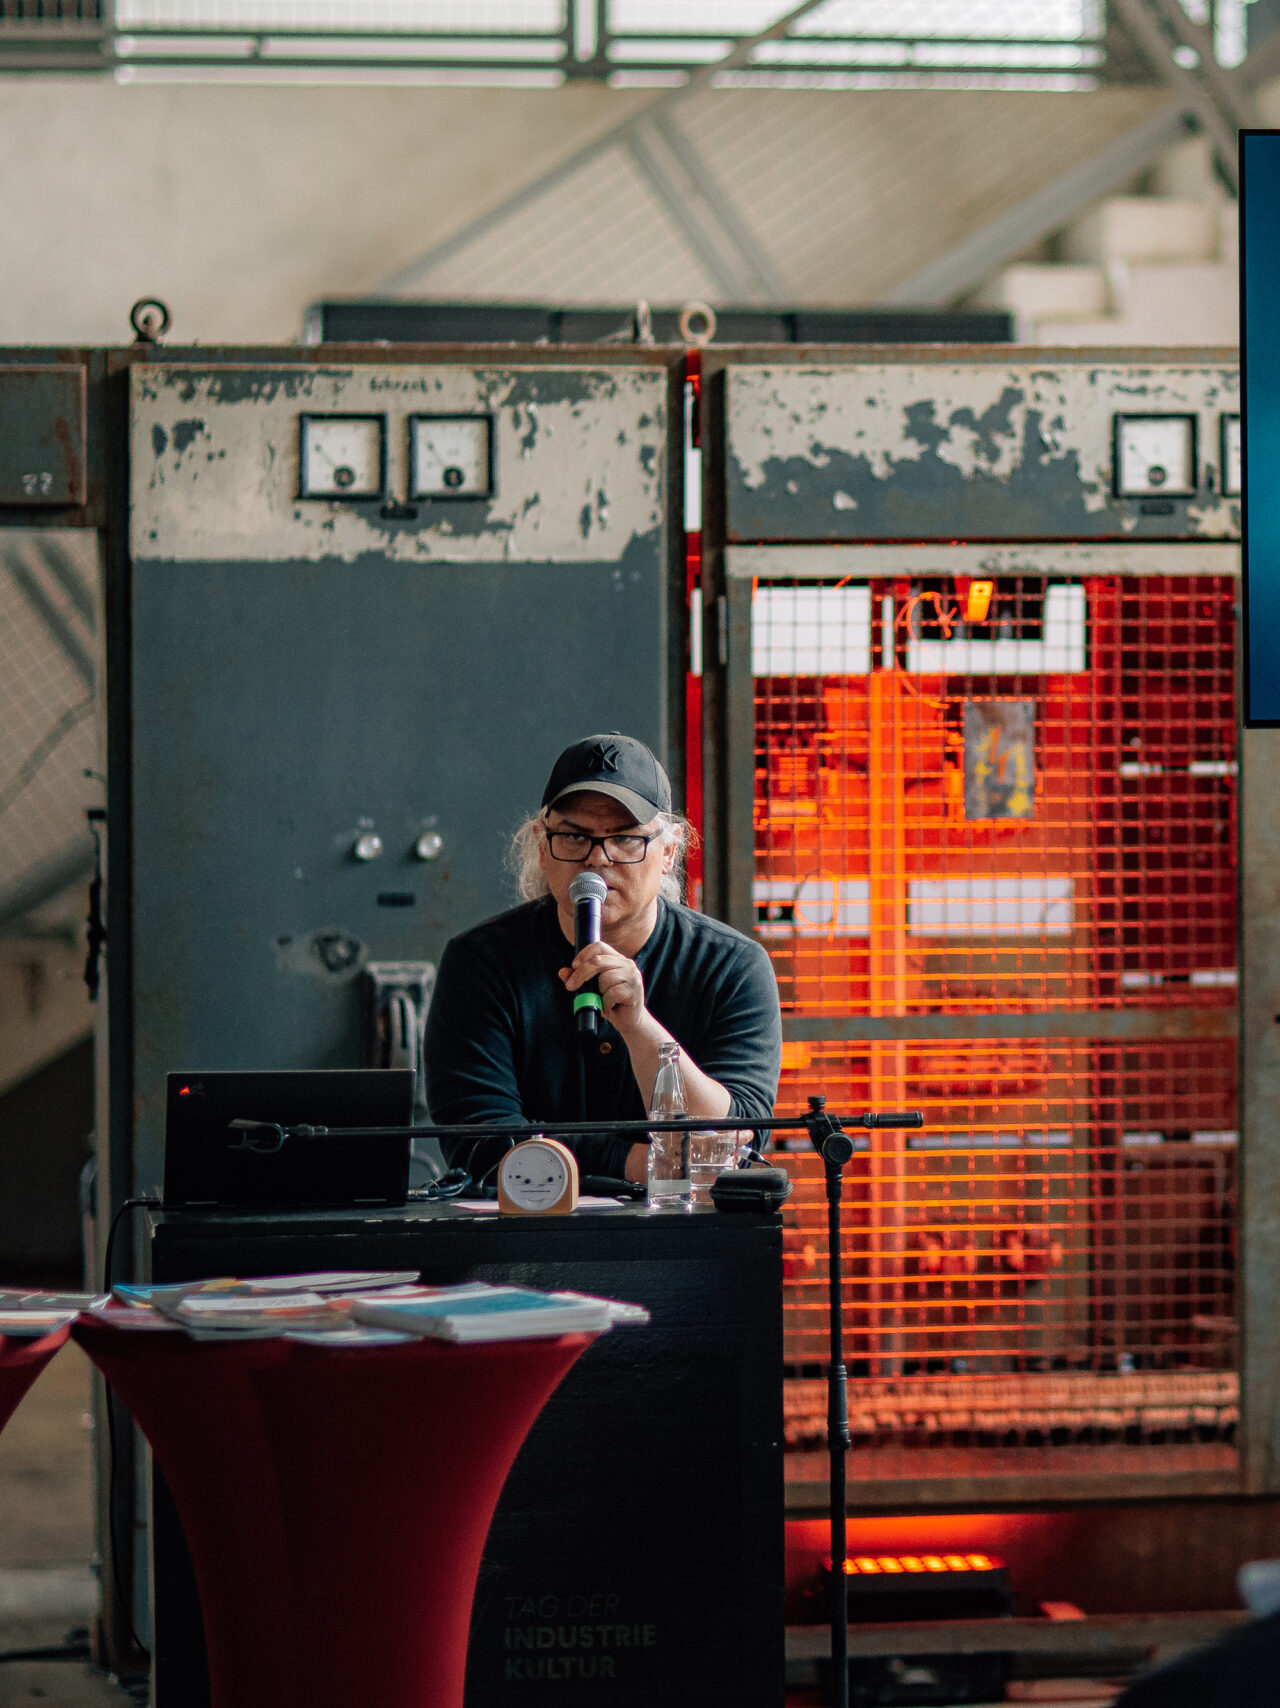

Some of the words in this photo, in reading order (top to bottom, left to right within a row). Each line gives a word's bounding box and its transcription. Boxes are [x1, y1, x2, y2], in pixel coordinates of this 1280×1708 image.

[505, 1595, 560, 1619] TAG
[568, 1593, 621, 1617] DER
[505, 1624, 656, 1649] INDUSTRIE
[505, 1656, 616, 1680] KULTUR
